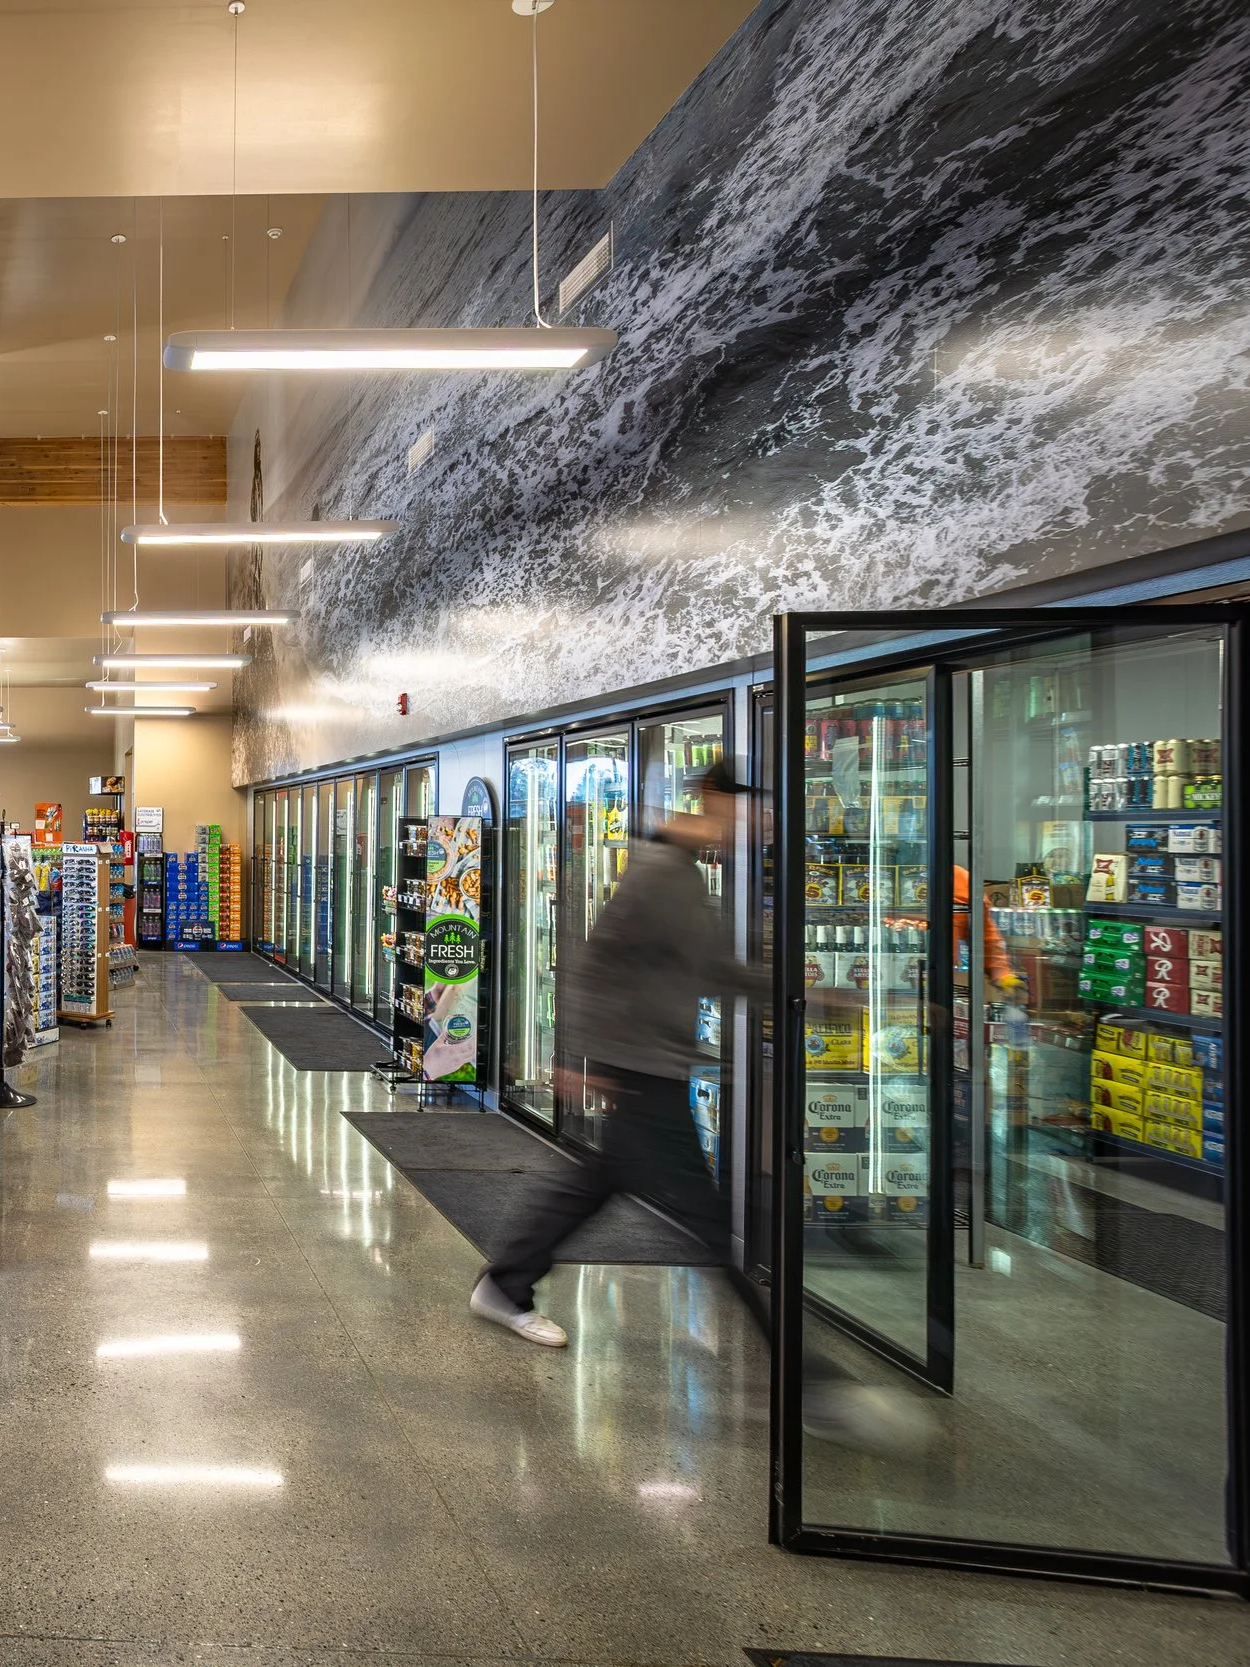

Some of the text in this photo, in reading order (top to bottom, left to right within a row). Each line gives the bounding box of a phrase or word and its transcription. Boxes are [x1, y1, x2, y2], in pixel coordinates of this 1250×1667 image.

[430, 924, 476, 939] MOUNTAIN
[430, 944, 474, 958] FRESH
[808, 1100, 852, 1114] Corona
[882, 1100, 925, 1114] Corona
[819, 1112, 841, 1121] Extra
[812, 1168, 855, 1182] Corona
[823, 1180, 845, 1189] Extra
[897, 1180, 918, 1189] Extra
